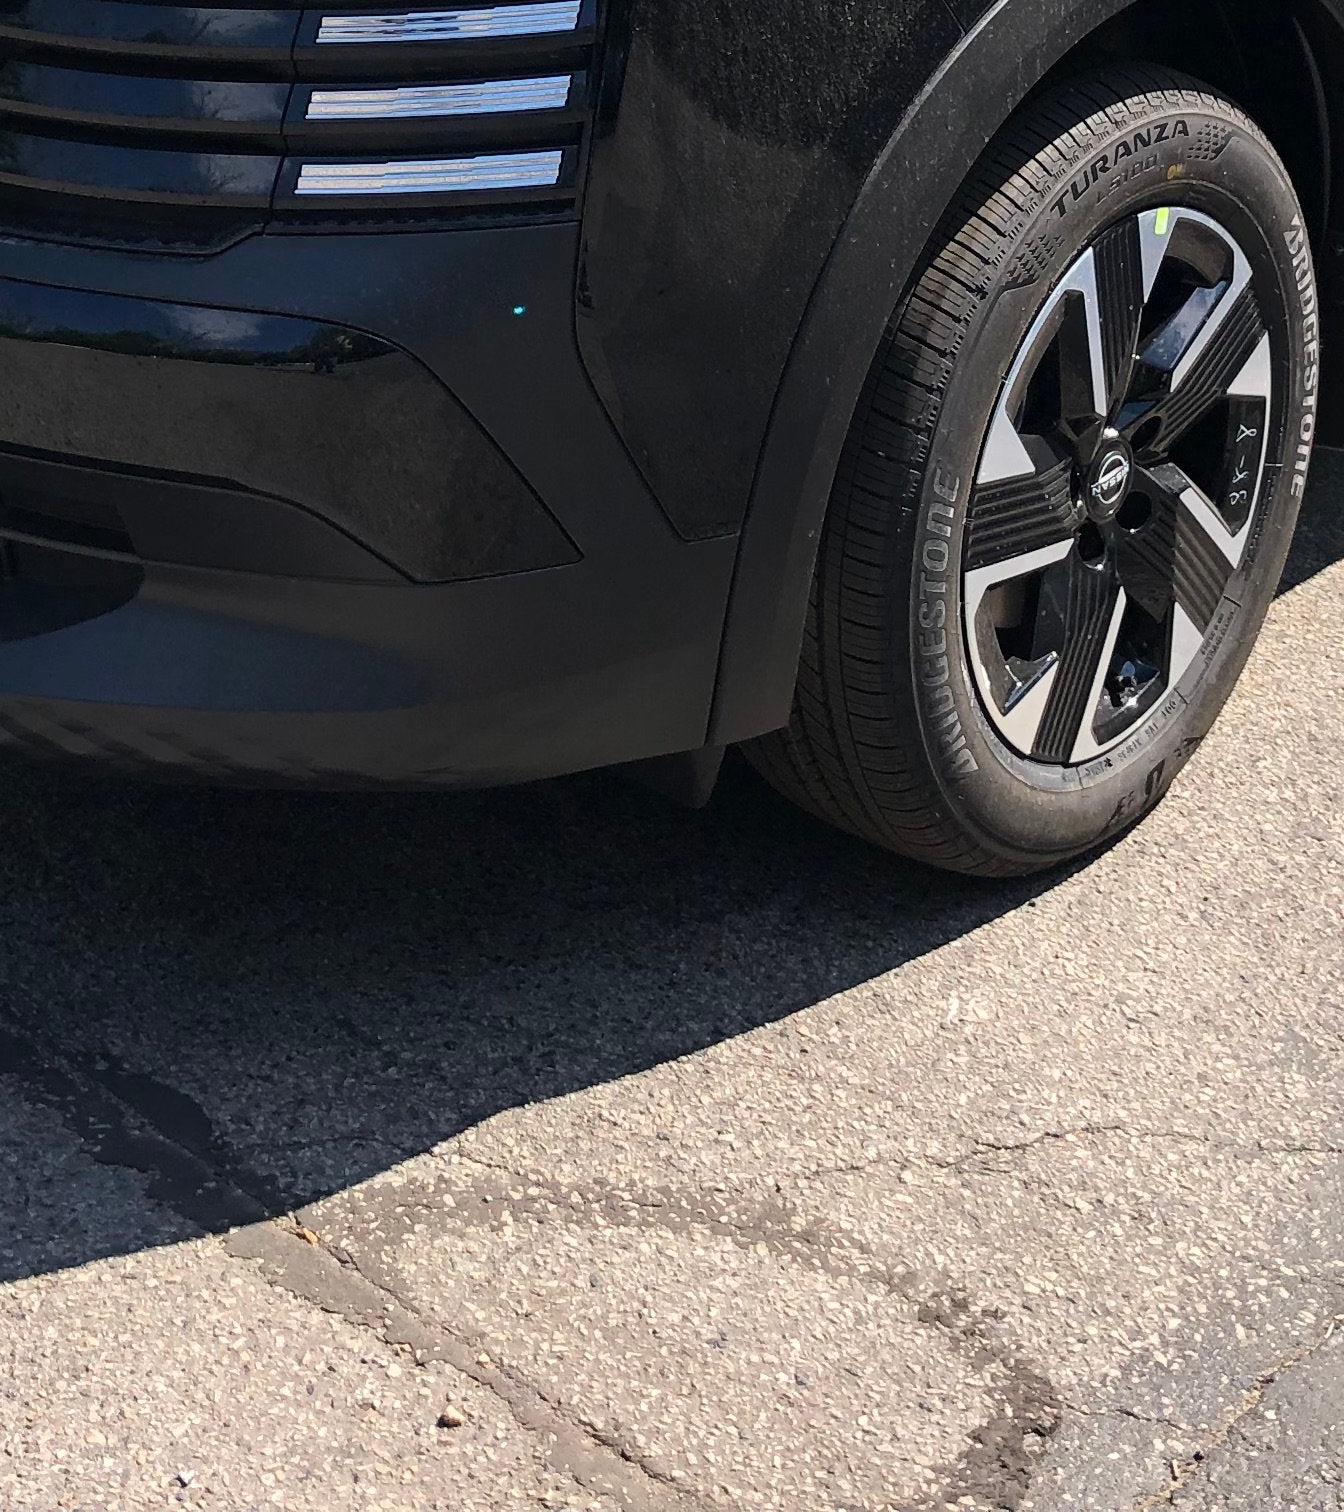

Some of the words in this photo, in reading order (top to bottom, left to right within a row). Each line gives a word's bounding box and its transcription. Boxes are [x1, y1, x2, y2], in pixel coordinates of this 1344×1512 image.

[1050, 119, 1190, 218] TURANZA
[1283, 213, 1318, 498] BRIDGESTONE
[918, 464, 979, 774] BRIDGESTONE
